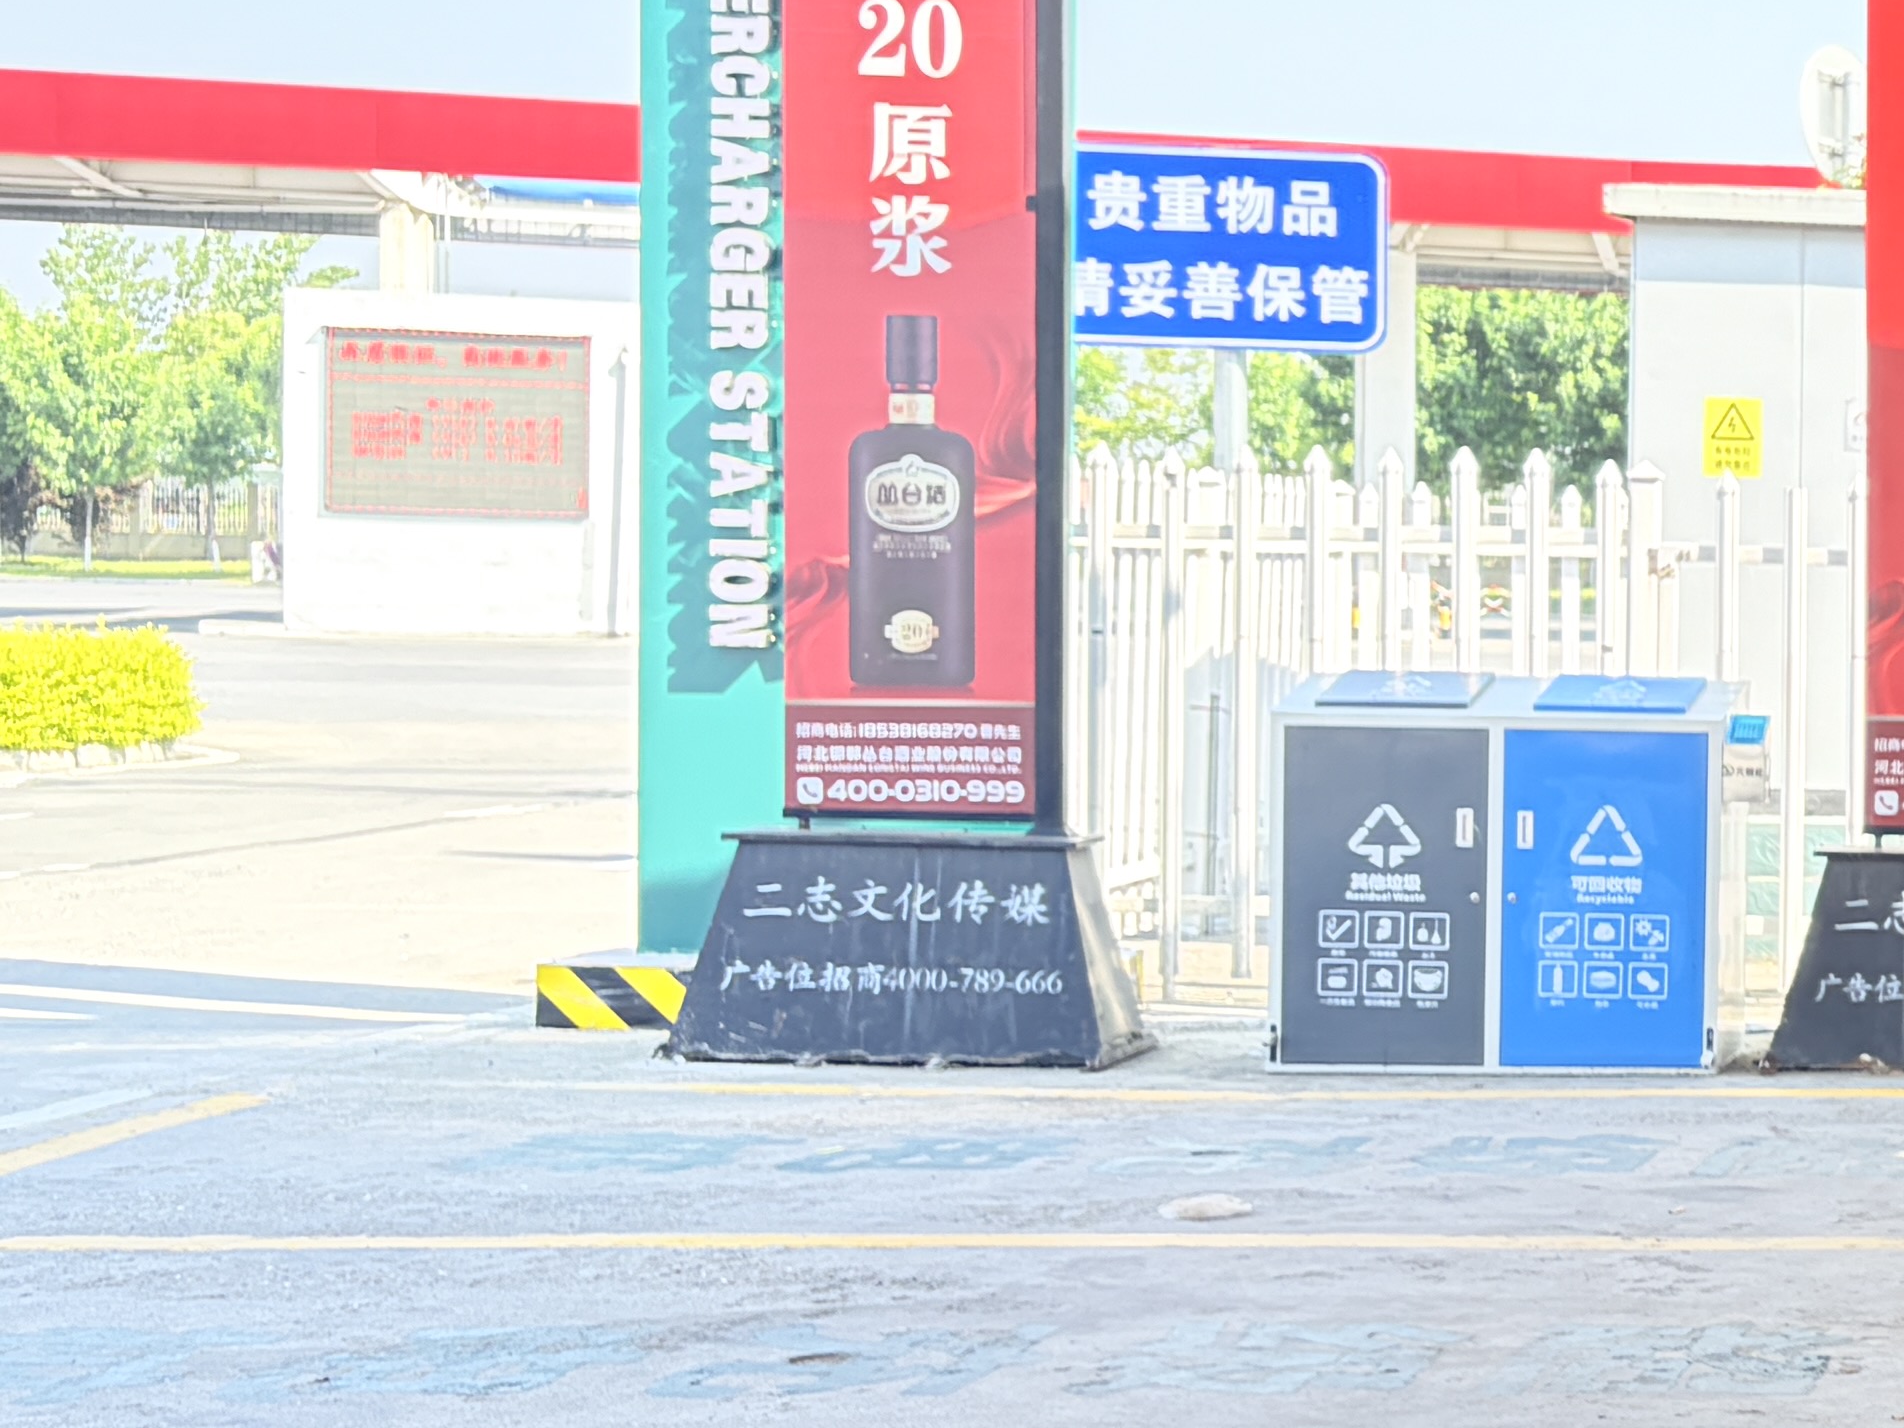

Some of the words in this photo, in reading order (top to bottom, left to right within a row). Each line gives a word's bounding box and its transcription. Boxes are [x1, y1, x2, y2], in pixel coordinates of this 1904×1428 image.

[1086, 170, 1339, 240] 贵重物品
[707, 370, 774, 649] STATION
[827, 778, 1025, 803] 400-0310-999
[741, 876, 1050, 928] 二志文化传媒
